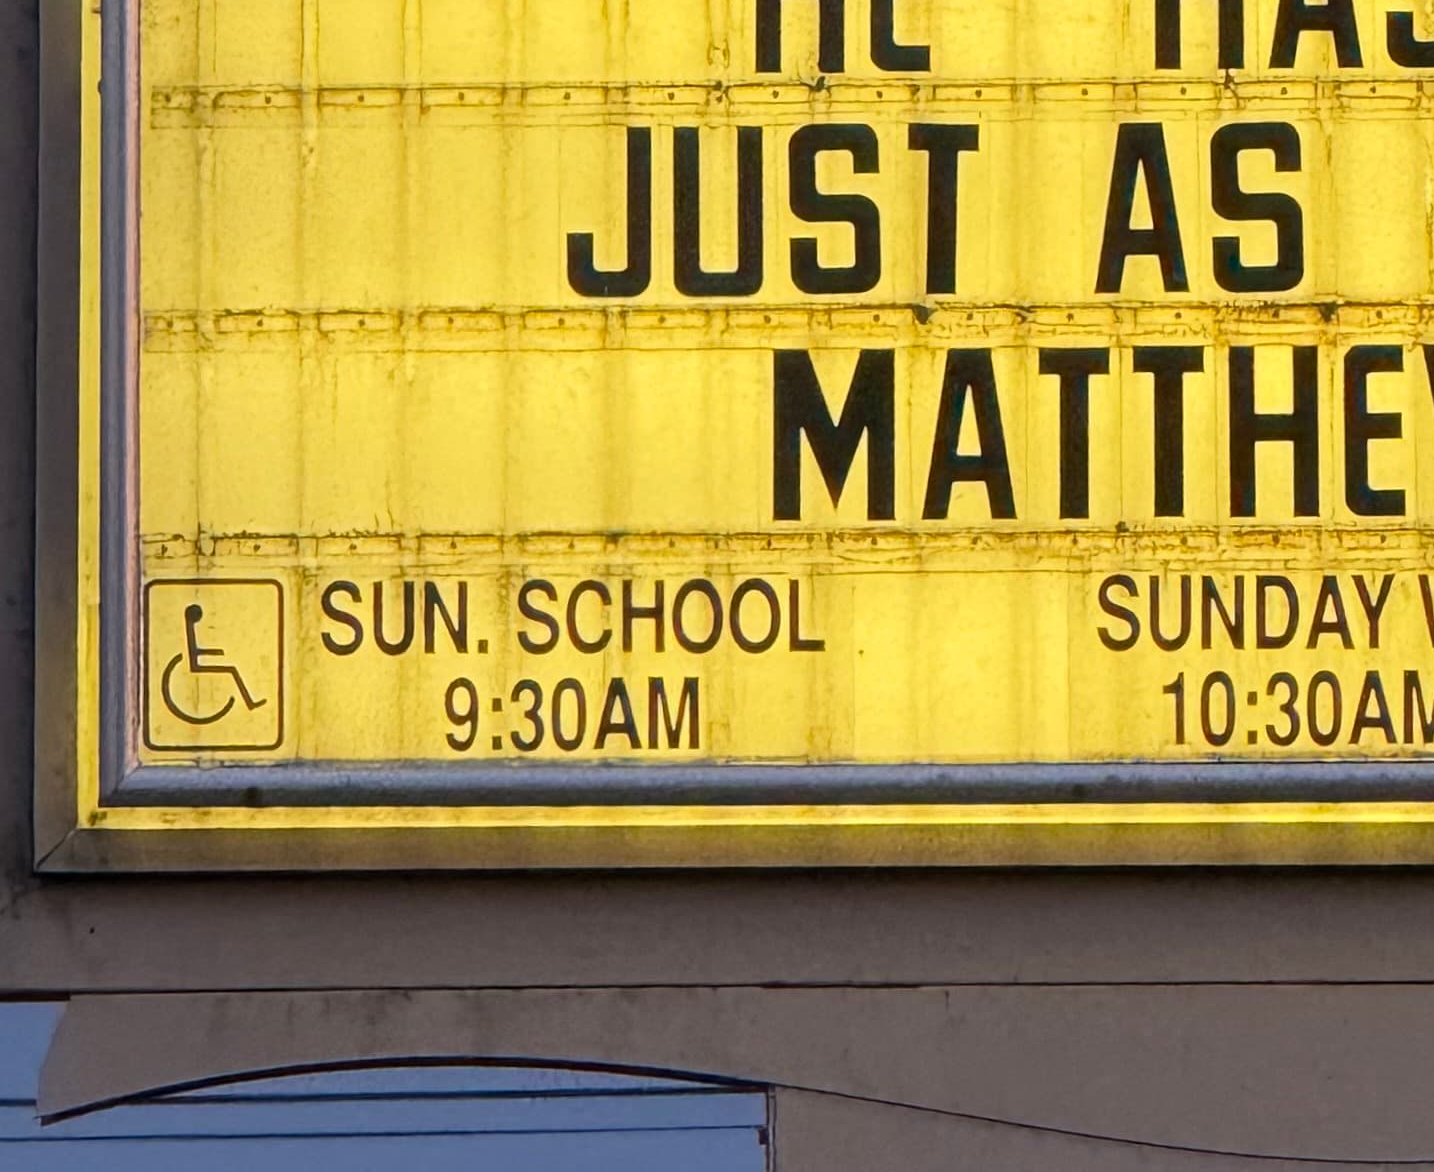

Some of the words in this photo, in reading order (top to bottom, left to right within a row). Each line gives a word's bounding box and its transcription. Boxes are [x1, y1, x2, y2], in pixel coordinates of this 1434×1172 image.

[568, 124, 980, 295] JUST
[1095, 122, 1302, 293] AS
[320, 579, 490, 657] SUN.
[518, 578, 826, 654] SCHOOL
[1098, 573, 1394, 650] SUNDAY
[444, 676, 702, 752] 9:30AM
